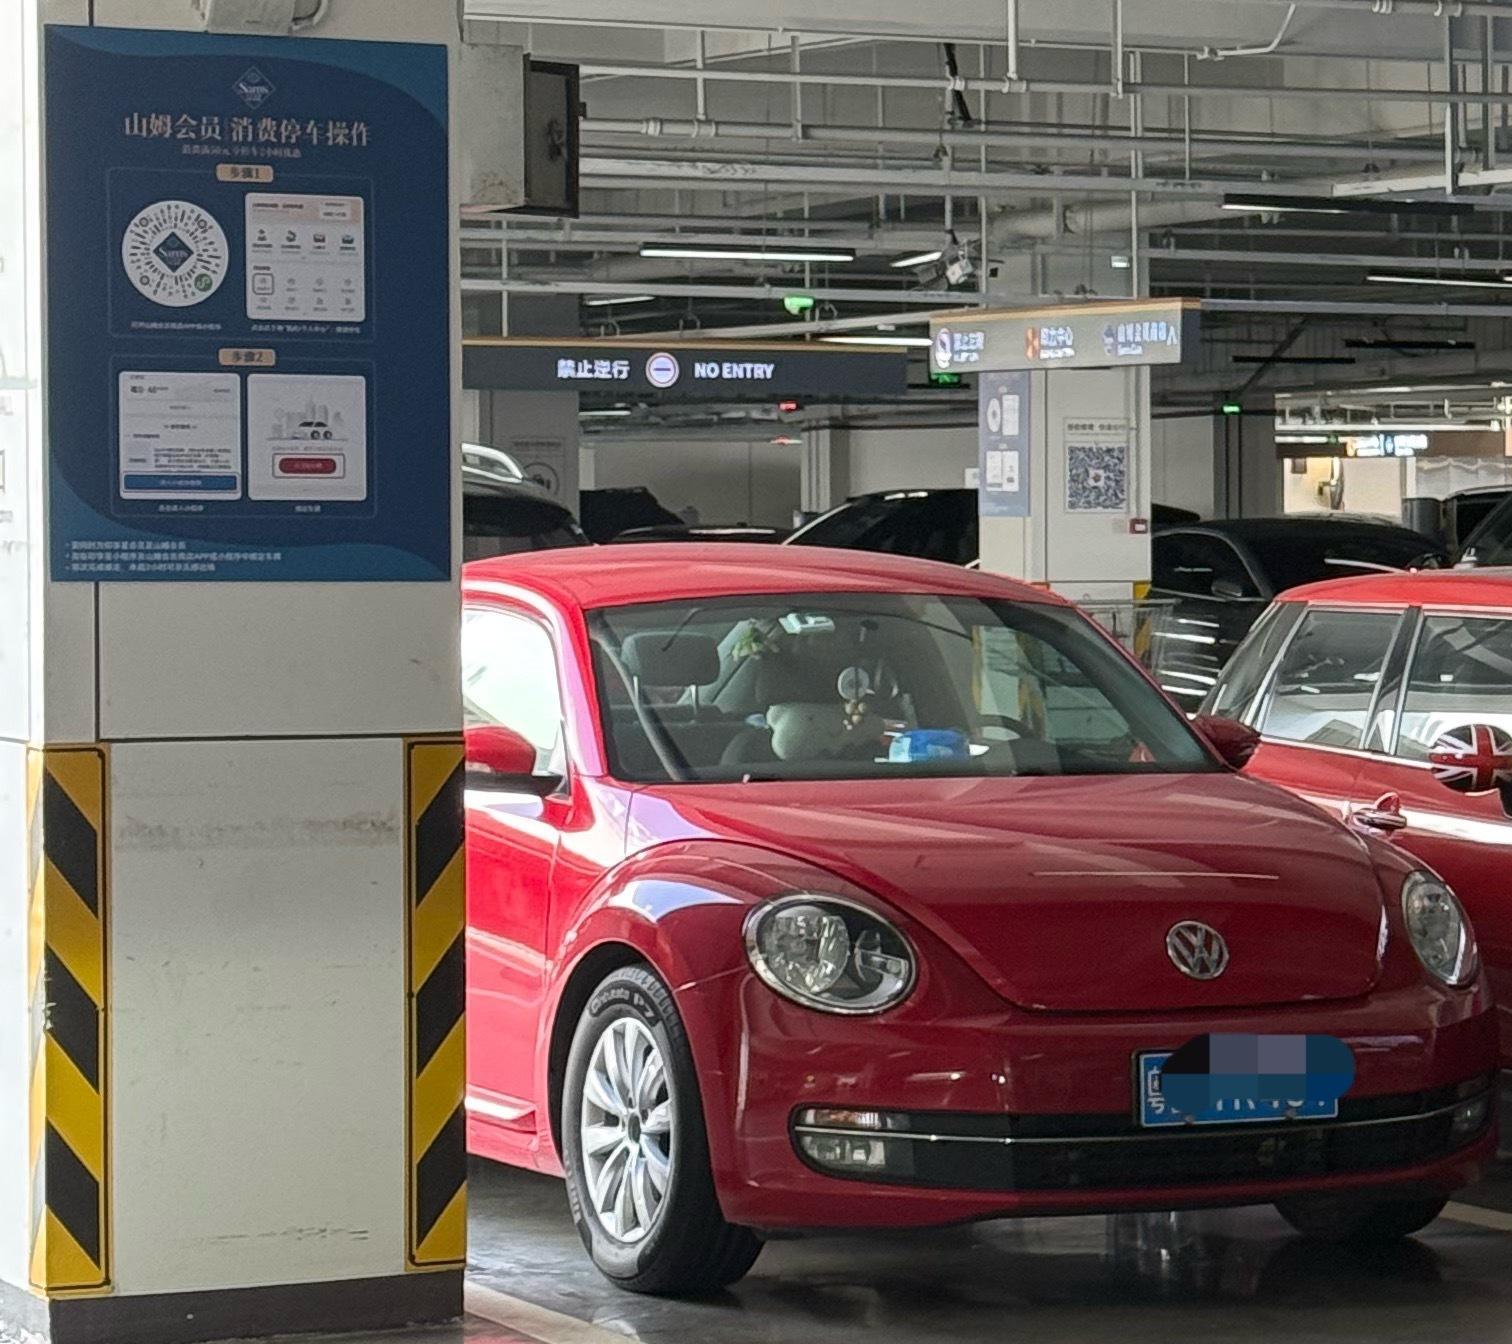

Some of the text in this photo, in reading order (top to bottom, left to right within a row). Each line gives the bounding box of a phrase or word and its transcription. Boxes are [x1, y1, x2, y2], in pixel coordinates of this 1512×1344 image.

[124, 112, 370, 147] 山姆会员 消费停车操作
[694, 361, 775, 380] NO ENTRY
